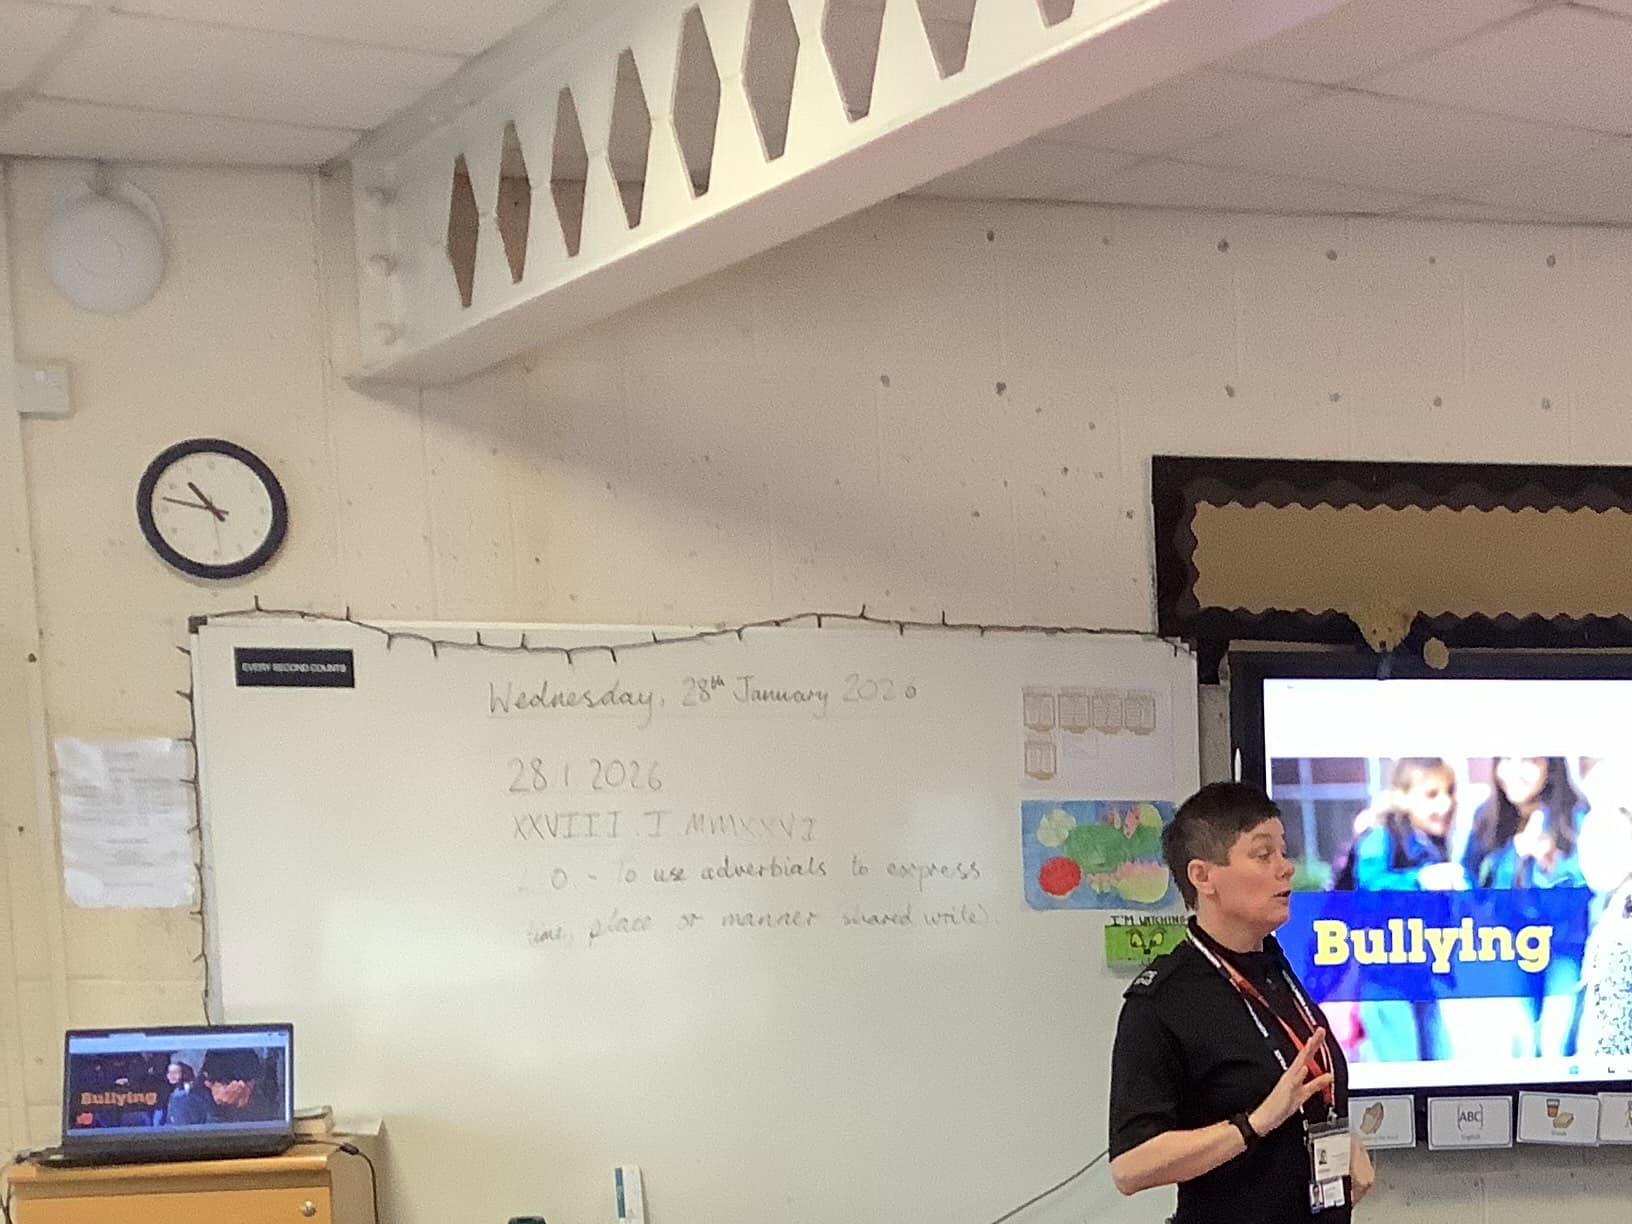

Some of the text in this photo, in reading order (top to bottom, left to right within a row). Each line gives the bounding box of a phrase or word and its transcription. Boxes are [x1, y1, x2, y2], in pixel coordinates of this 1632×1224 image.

[242, 662, 347, 673] EVERY SECOND COUNTS
[732, 674, 830, 719] January
[701, 854, 828, 881] adverbials
[850, 855, 873, 878] to
[1313, 918, 1554, 973] Bullying
[80, 1091, 158, 1106] Bullying
